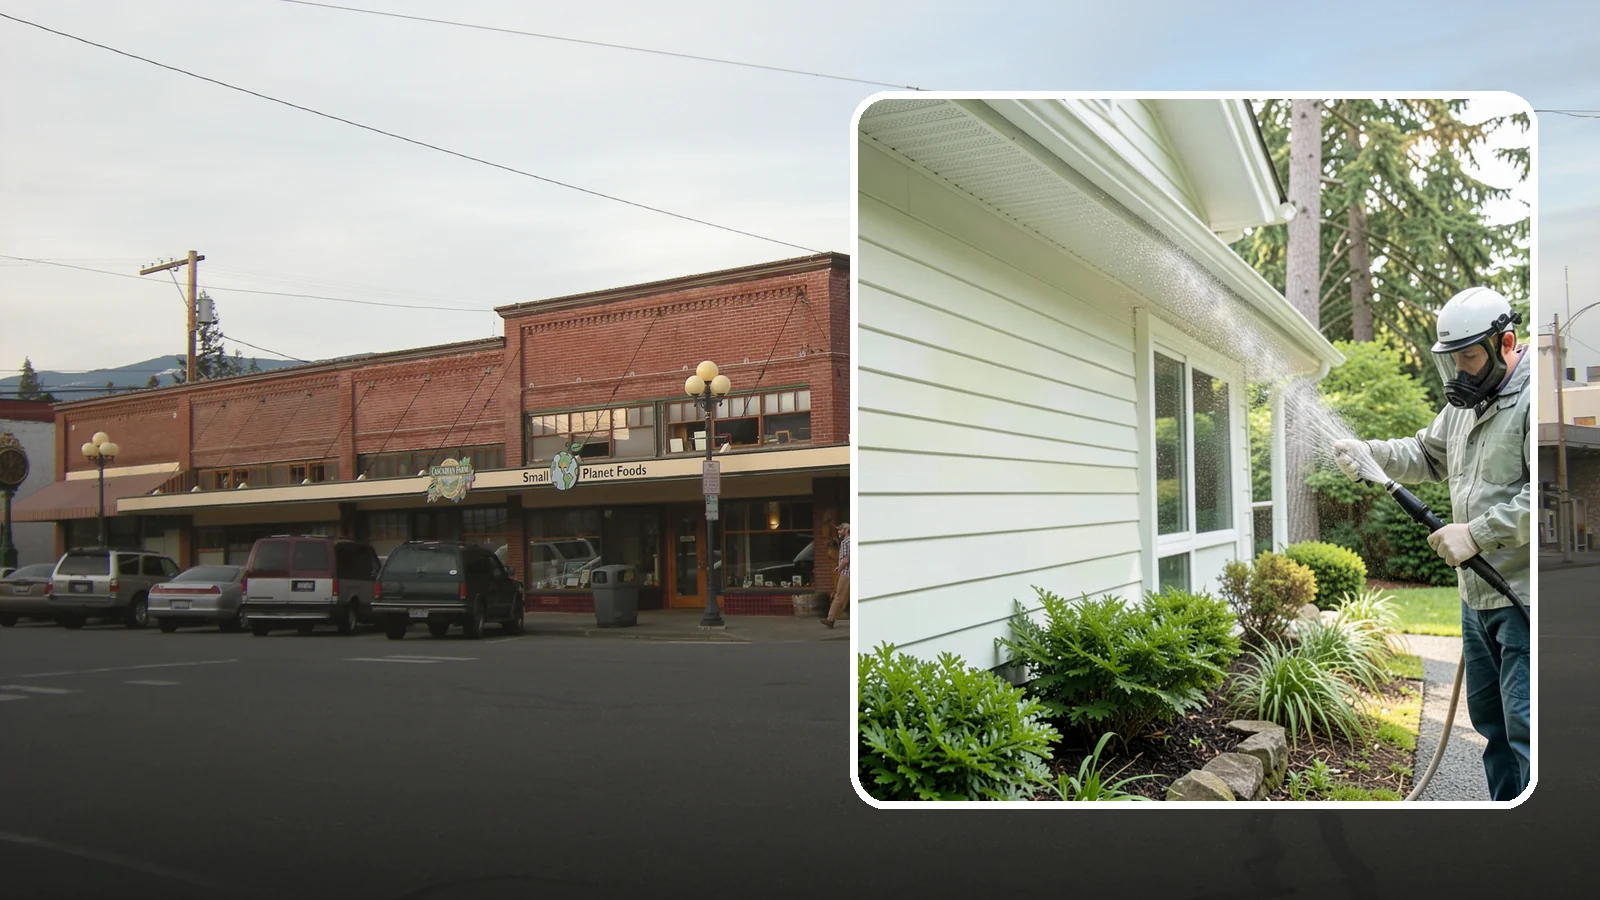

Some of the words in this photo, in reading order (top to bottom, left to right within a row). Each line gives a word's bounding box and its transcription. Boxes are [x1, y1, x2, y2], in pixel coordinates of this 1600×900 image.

[523, 471, 549, 483] Small
[582, 467, 614, 479] Planet
[617, 464, 647, 477] Foods
